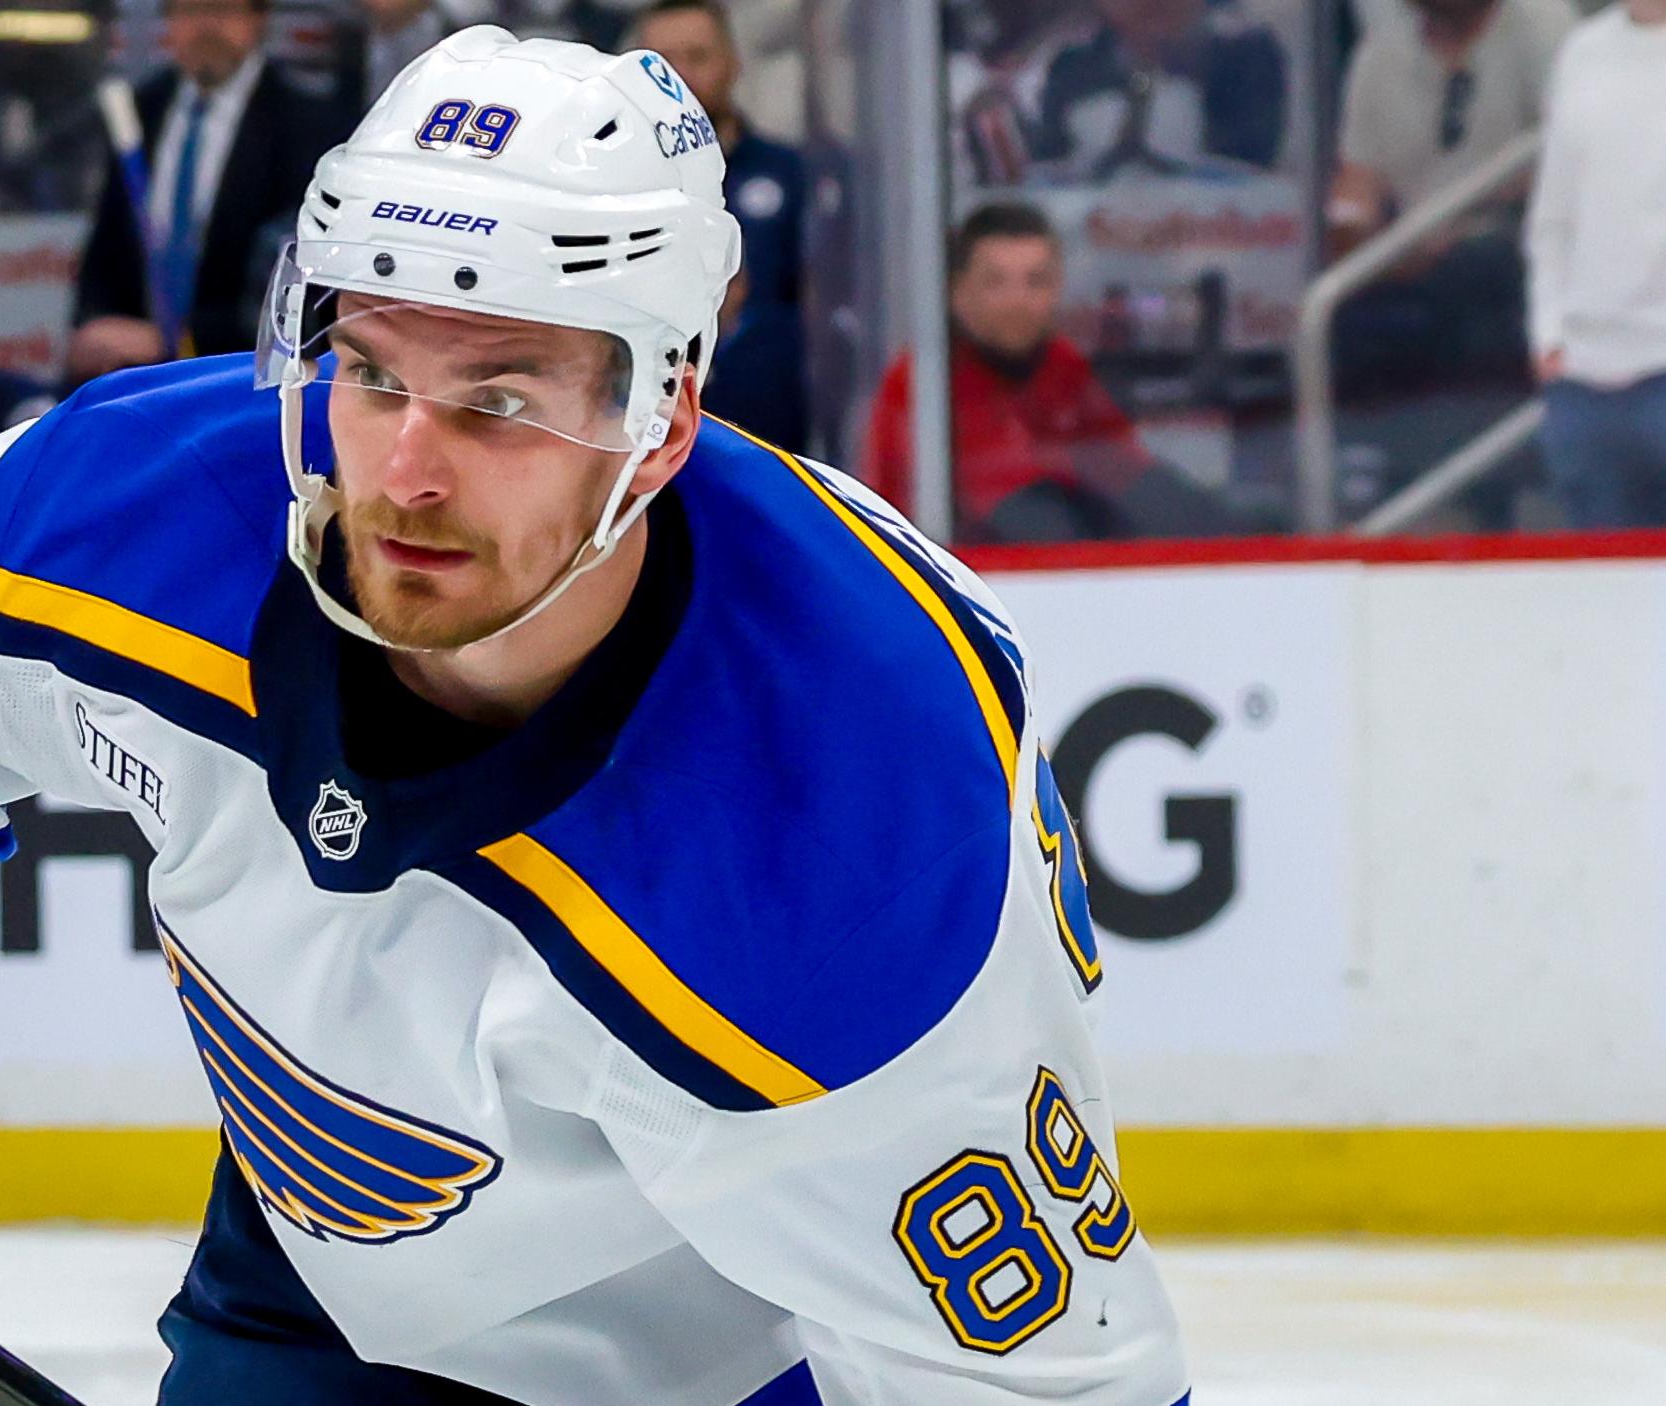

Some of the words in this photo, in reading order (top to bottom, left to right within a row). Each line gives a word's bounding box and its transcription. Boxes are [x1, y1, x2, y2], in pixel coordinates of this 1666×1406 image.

[416, 99, 521, 159] 89
[653, 108, 719, 159] CarShie
[372, 201, 499, 236] BAUER
[75, 702, 167, 826] STIFEL
[319, 813, 354, 834] NHL
[892, 1065, 1137, 1356] 89
